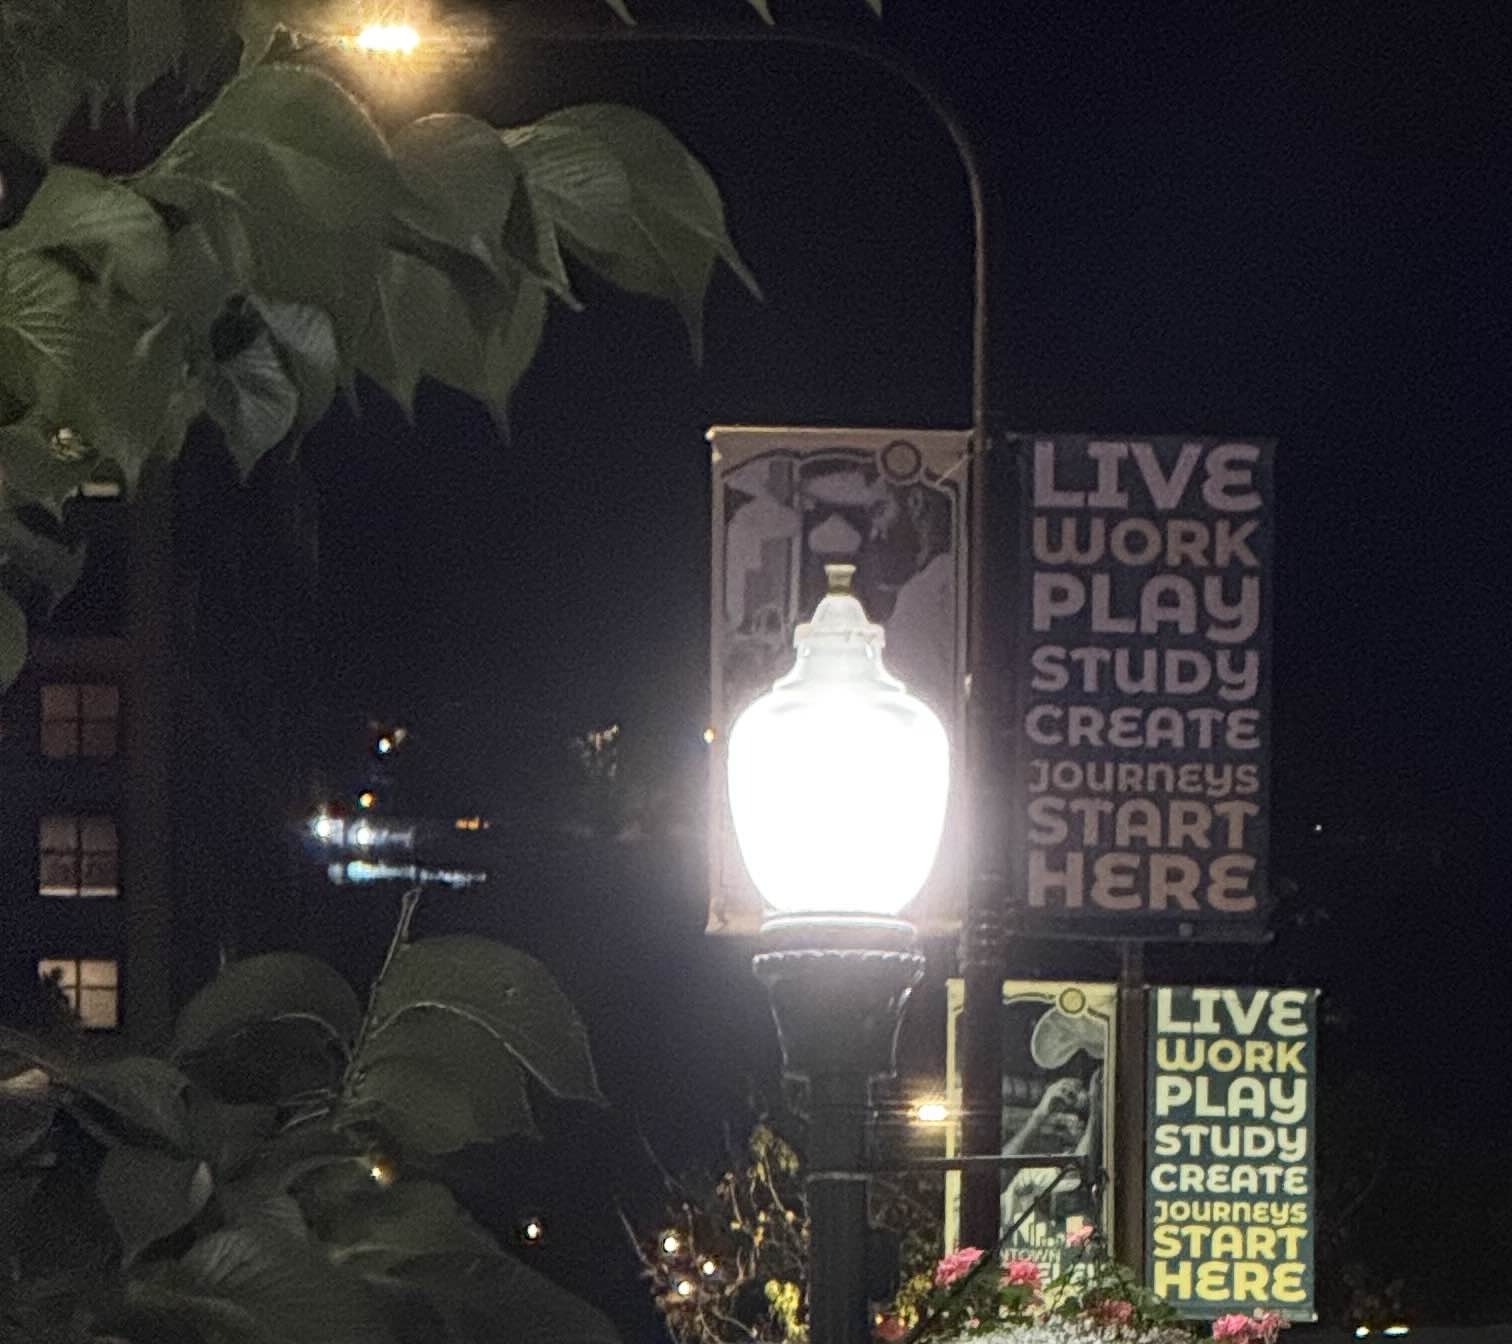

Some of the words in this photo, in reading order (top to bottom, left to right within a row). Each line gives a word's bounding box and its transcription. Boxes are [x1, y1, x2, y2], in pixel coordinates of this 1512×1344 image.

[1033, 441, 1262, 510] LIVE
[1032, 517, 1260, 567] WORK
[1032, 571, 1260, 643] PLAY
[1031, 645, 1259, 701] STUDY
[1025, 705, 1260, 749] CREATE
[1028, 759, 1259, 796] JOURNEYS
[1027, 797, 1259, 848] START
[1027, 850, 1257, 912] HERE
[1157, 988, 1308, 1036] LIVE
[1156, 1039, 1306, 1073] WORK
[1156, 1075, 1307, 1124] PLAY
[1154, 1124, 1307, 1162] STUDY
[1151, 1163, 1308, 1195] CREATE
[1154, 1200, 1307, 1225] JOURNEYS
[1153, 1225, 1308, 1259] START
[1154, 1260, 1306, 1302] HERE
